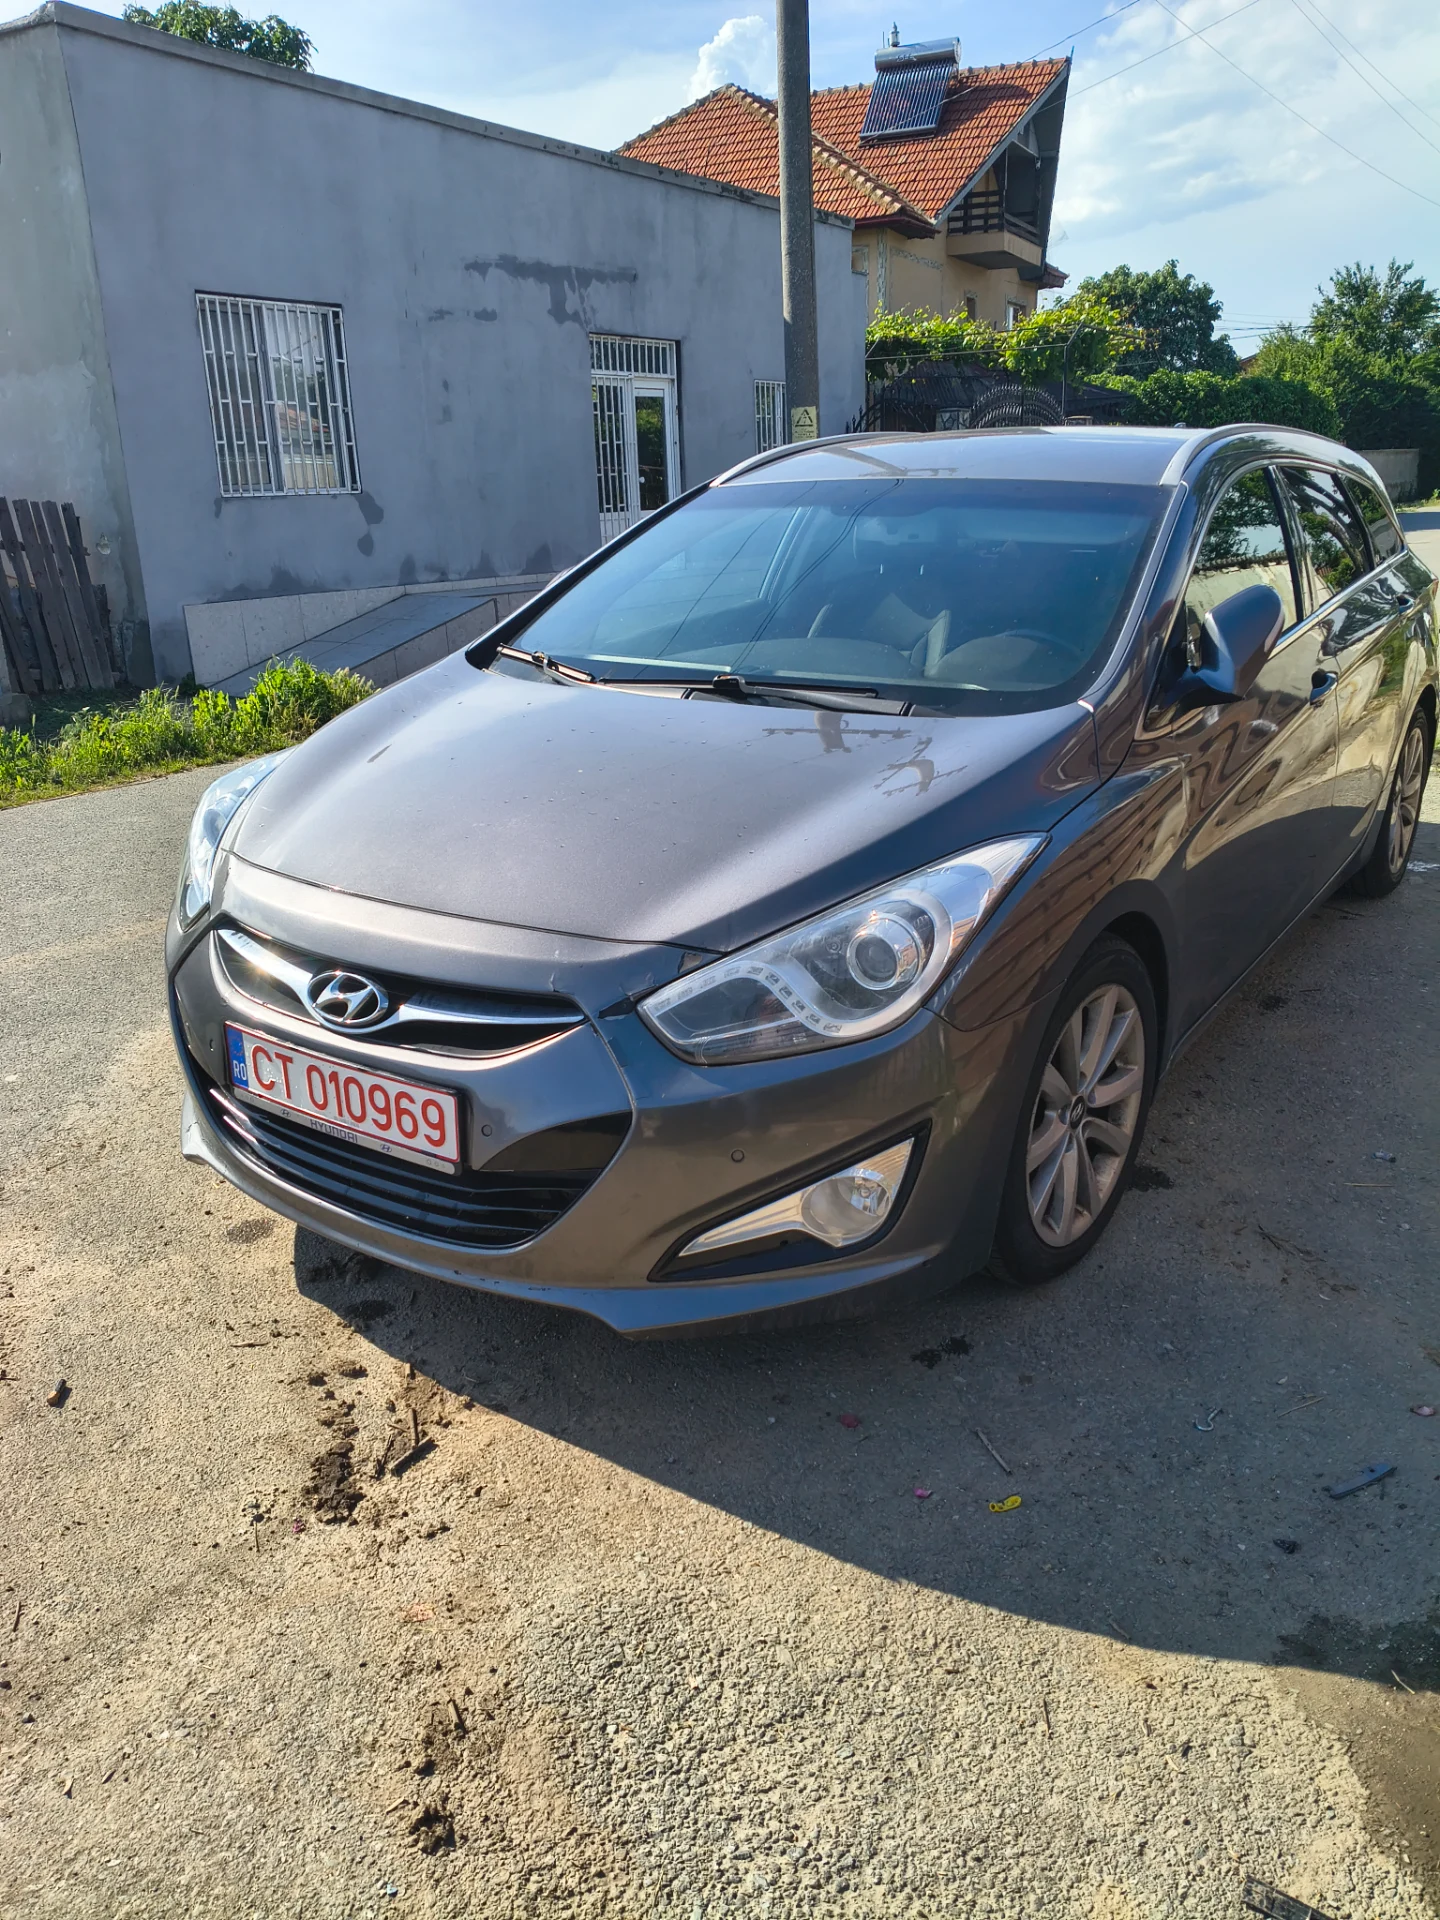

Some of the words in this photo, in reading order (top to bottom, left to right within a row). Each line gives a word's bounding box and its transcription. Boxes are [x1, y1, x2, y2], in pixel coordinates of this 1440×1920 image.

[233, 1060, 247, 1081] RO
[251, 1044, 294, 1100] CT
[306, 1064, 446, 1148] 010969
[310, 1119, 358, 1144] HYUNDAI
